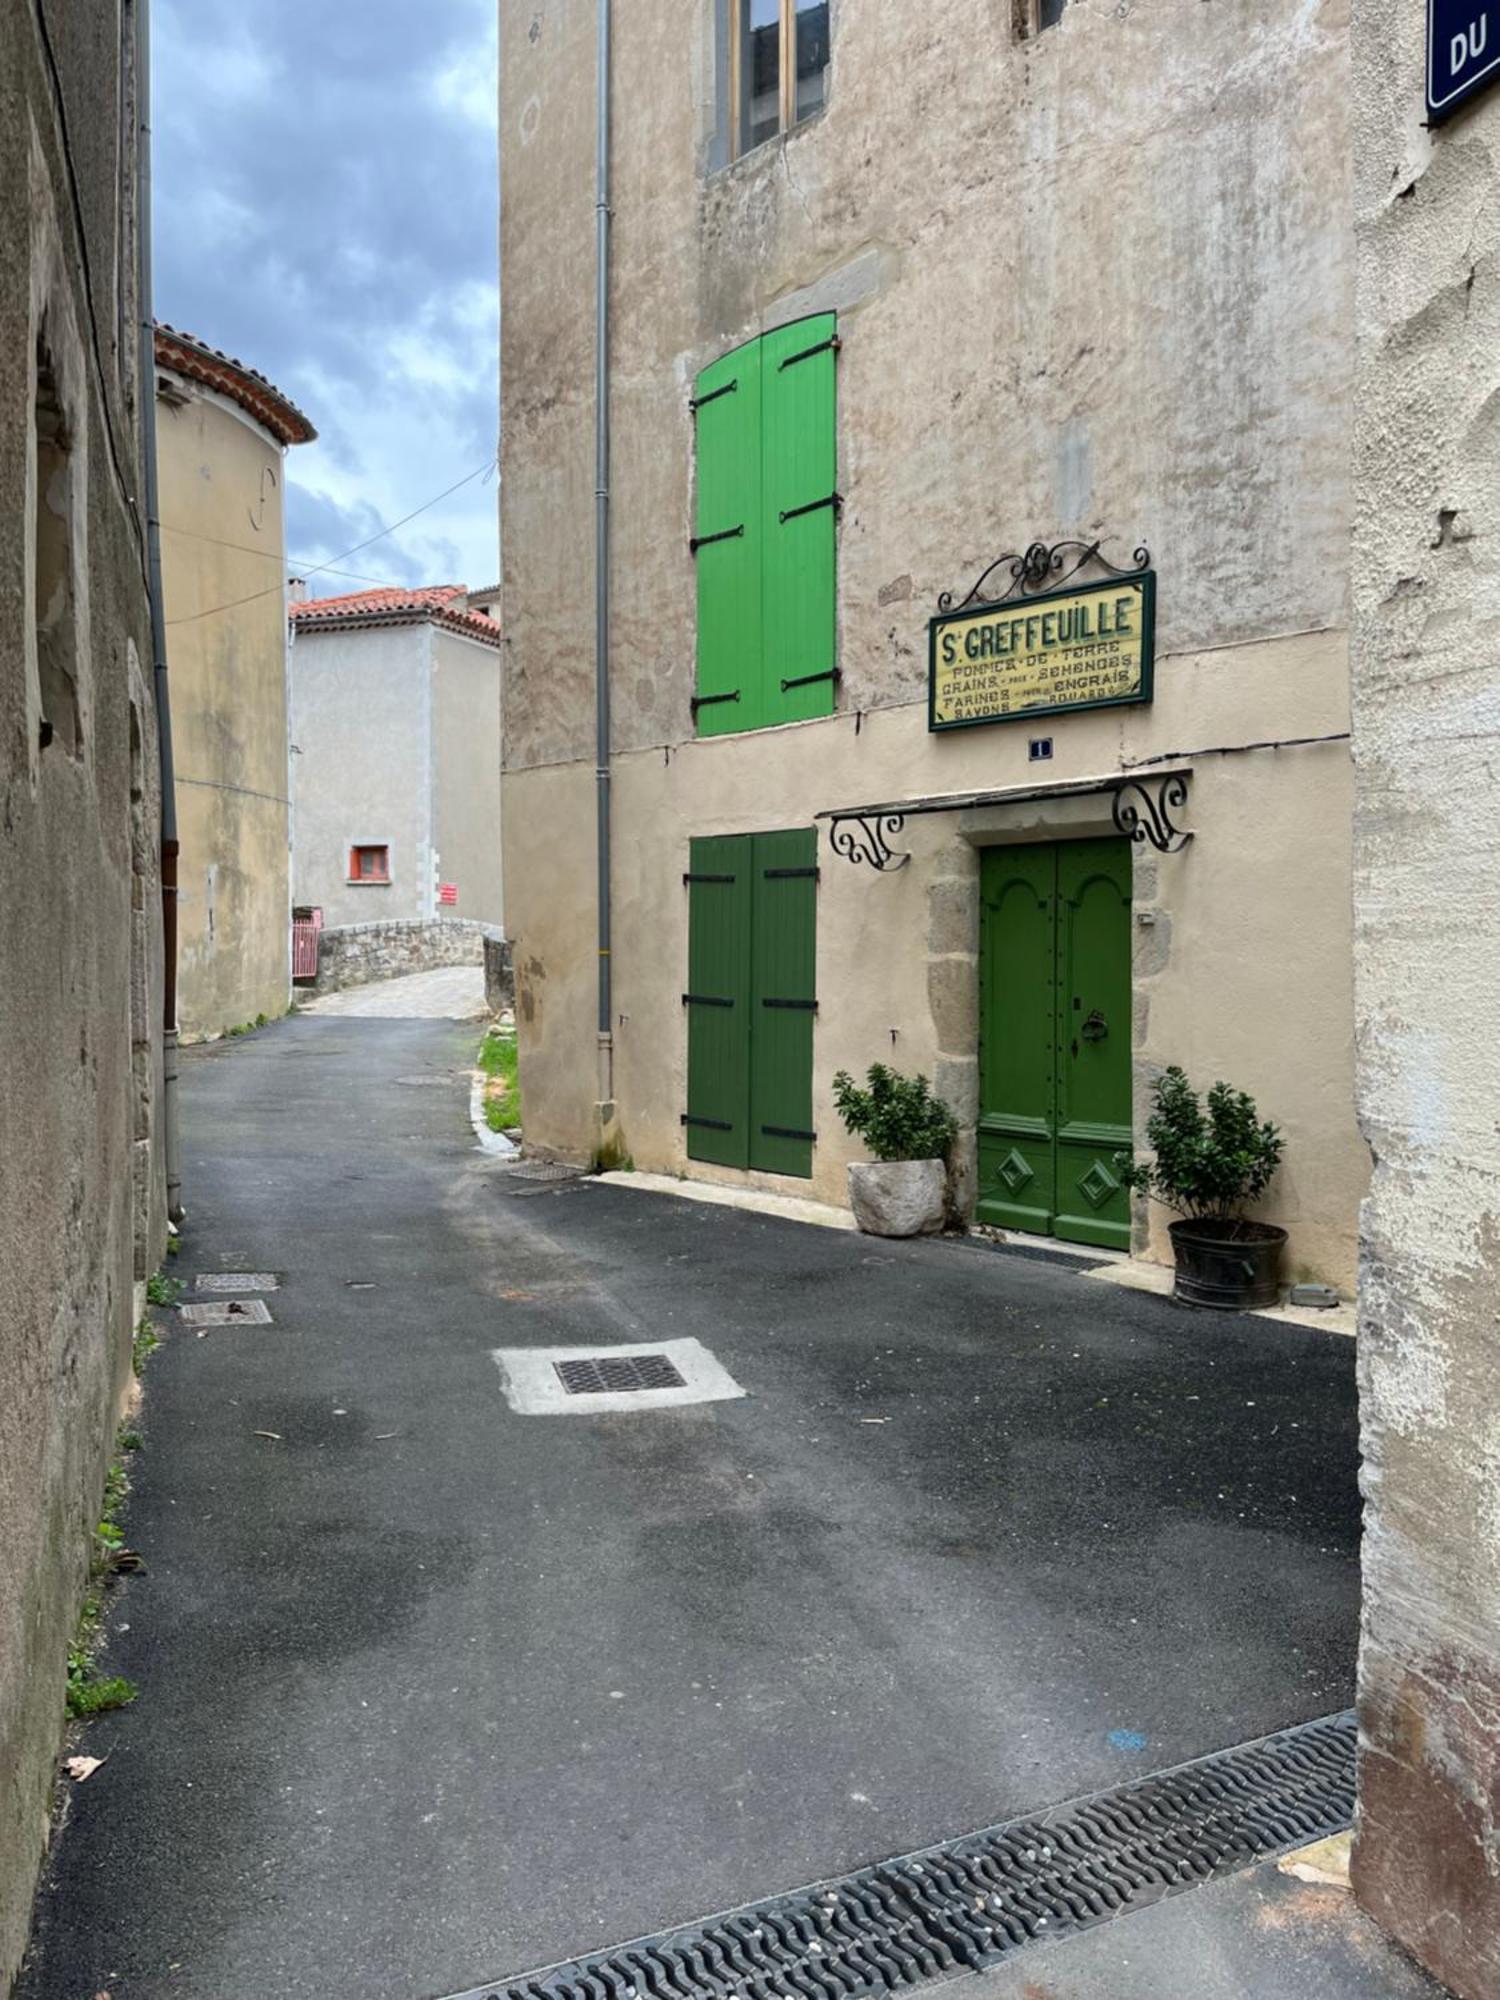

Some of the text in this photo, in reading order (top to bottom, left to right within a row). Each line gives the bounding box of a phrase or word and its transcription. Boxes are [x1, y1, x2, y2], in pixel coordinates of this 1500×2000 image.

[1450, 13, 1487, 76] DU
[1027, 652, 1047, 667] DE
[1062, 640, 1120, 660] TERRE
[943, 676, 998, 695] GRAINS
[943, 689, 1010, 709] FARINES
[1054, 669, 1129, 692] ENGRAIS
[954, 702, 1010, 720] SAVONS
